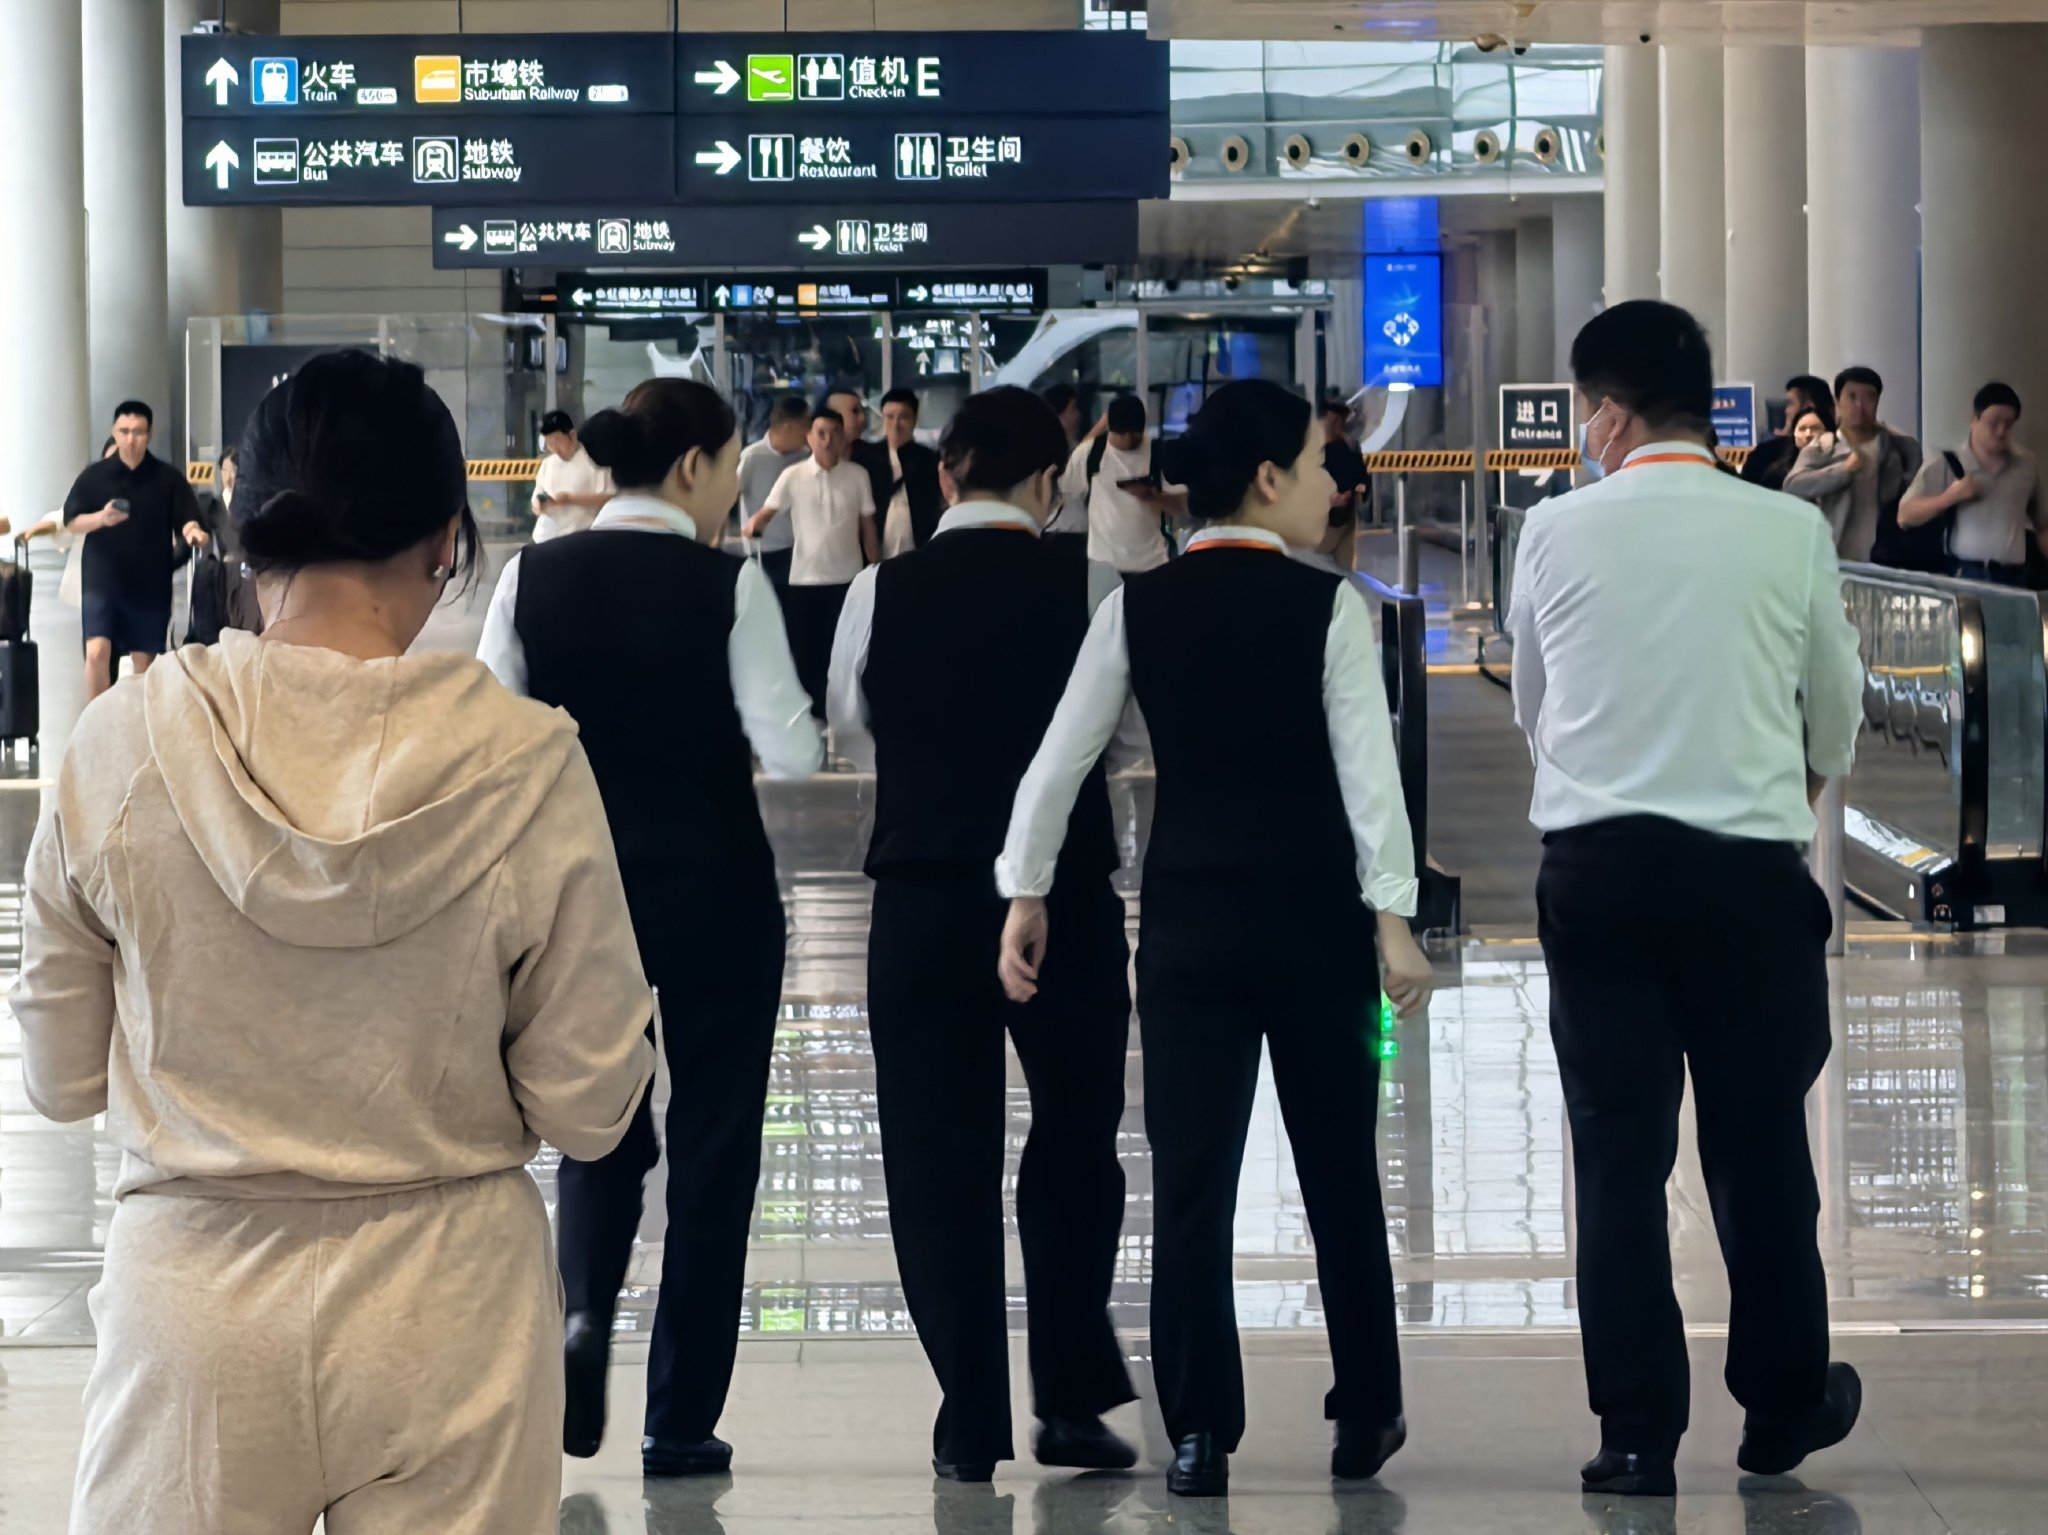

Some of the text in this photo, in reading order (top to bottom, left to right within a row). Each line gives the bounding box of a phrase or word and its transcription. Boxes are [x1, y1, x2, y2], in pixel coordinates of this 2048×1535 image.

[302, 60, 356, 89] 火车
[464, 59, 545, 87] 市域铁
[848, 55, 940, 97] 值机 E
[302, 88, 338, 102] Train
[464, 87, 526, 101] Suburban
[529, 87, 580, 102] Railway
[848, 85, 906, 98] Check-in
[303, 139, 405, 168] 公共汽车
[464, 138, 515, 165] 地铁
[799, 136, 851, 164] 餐饮
[945, 136, 1021, 163] 卫生间
[303, 166, 329, 181] Bus
[462, 164, 523, 182] Subway
[799, 163, 878, 179] Restaurant
[946, 163, 989, 178] Toilet
[519, 221, 592, 241] 公共汽车
[633, 220, 671, 240] 地铁
[873, 221, 928, 242] 卫生间
[632, 239, 676, 252] Subway
[1516, 400, 1558, 423] 进口
